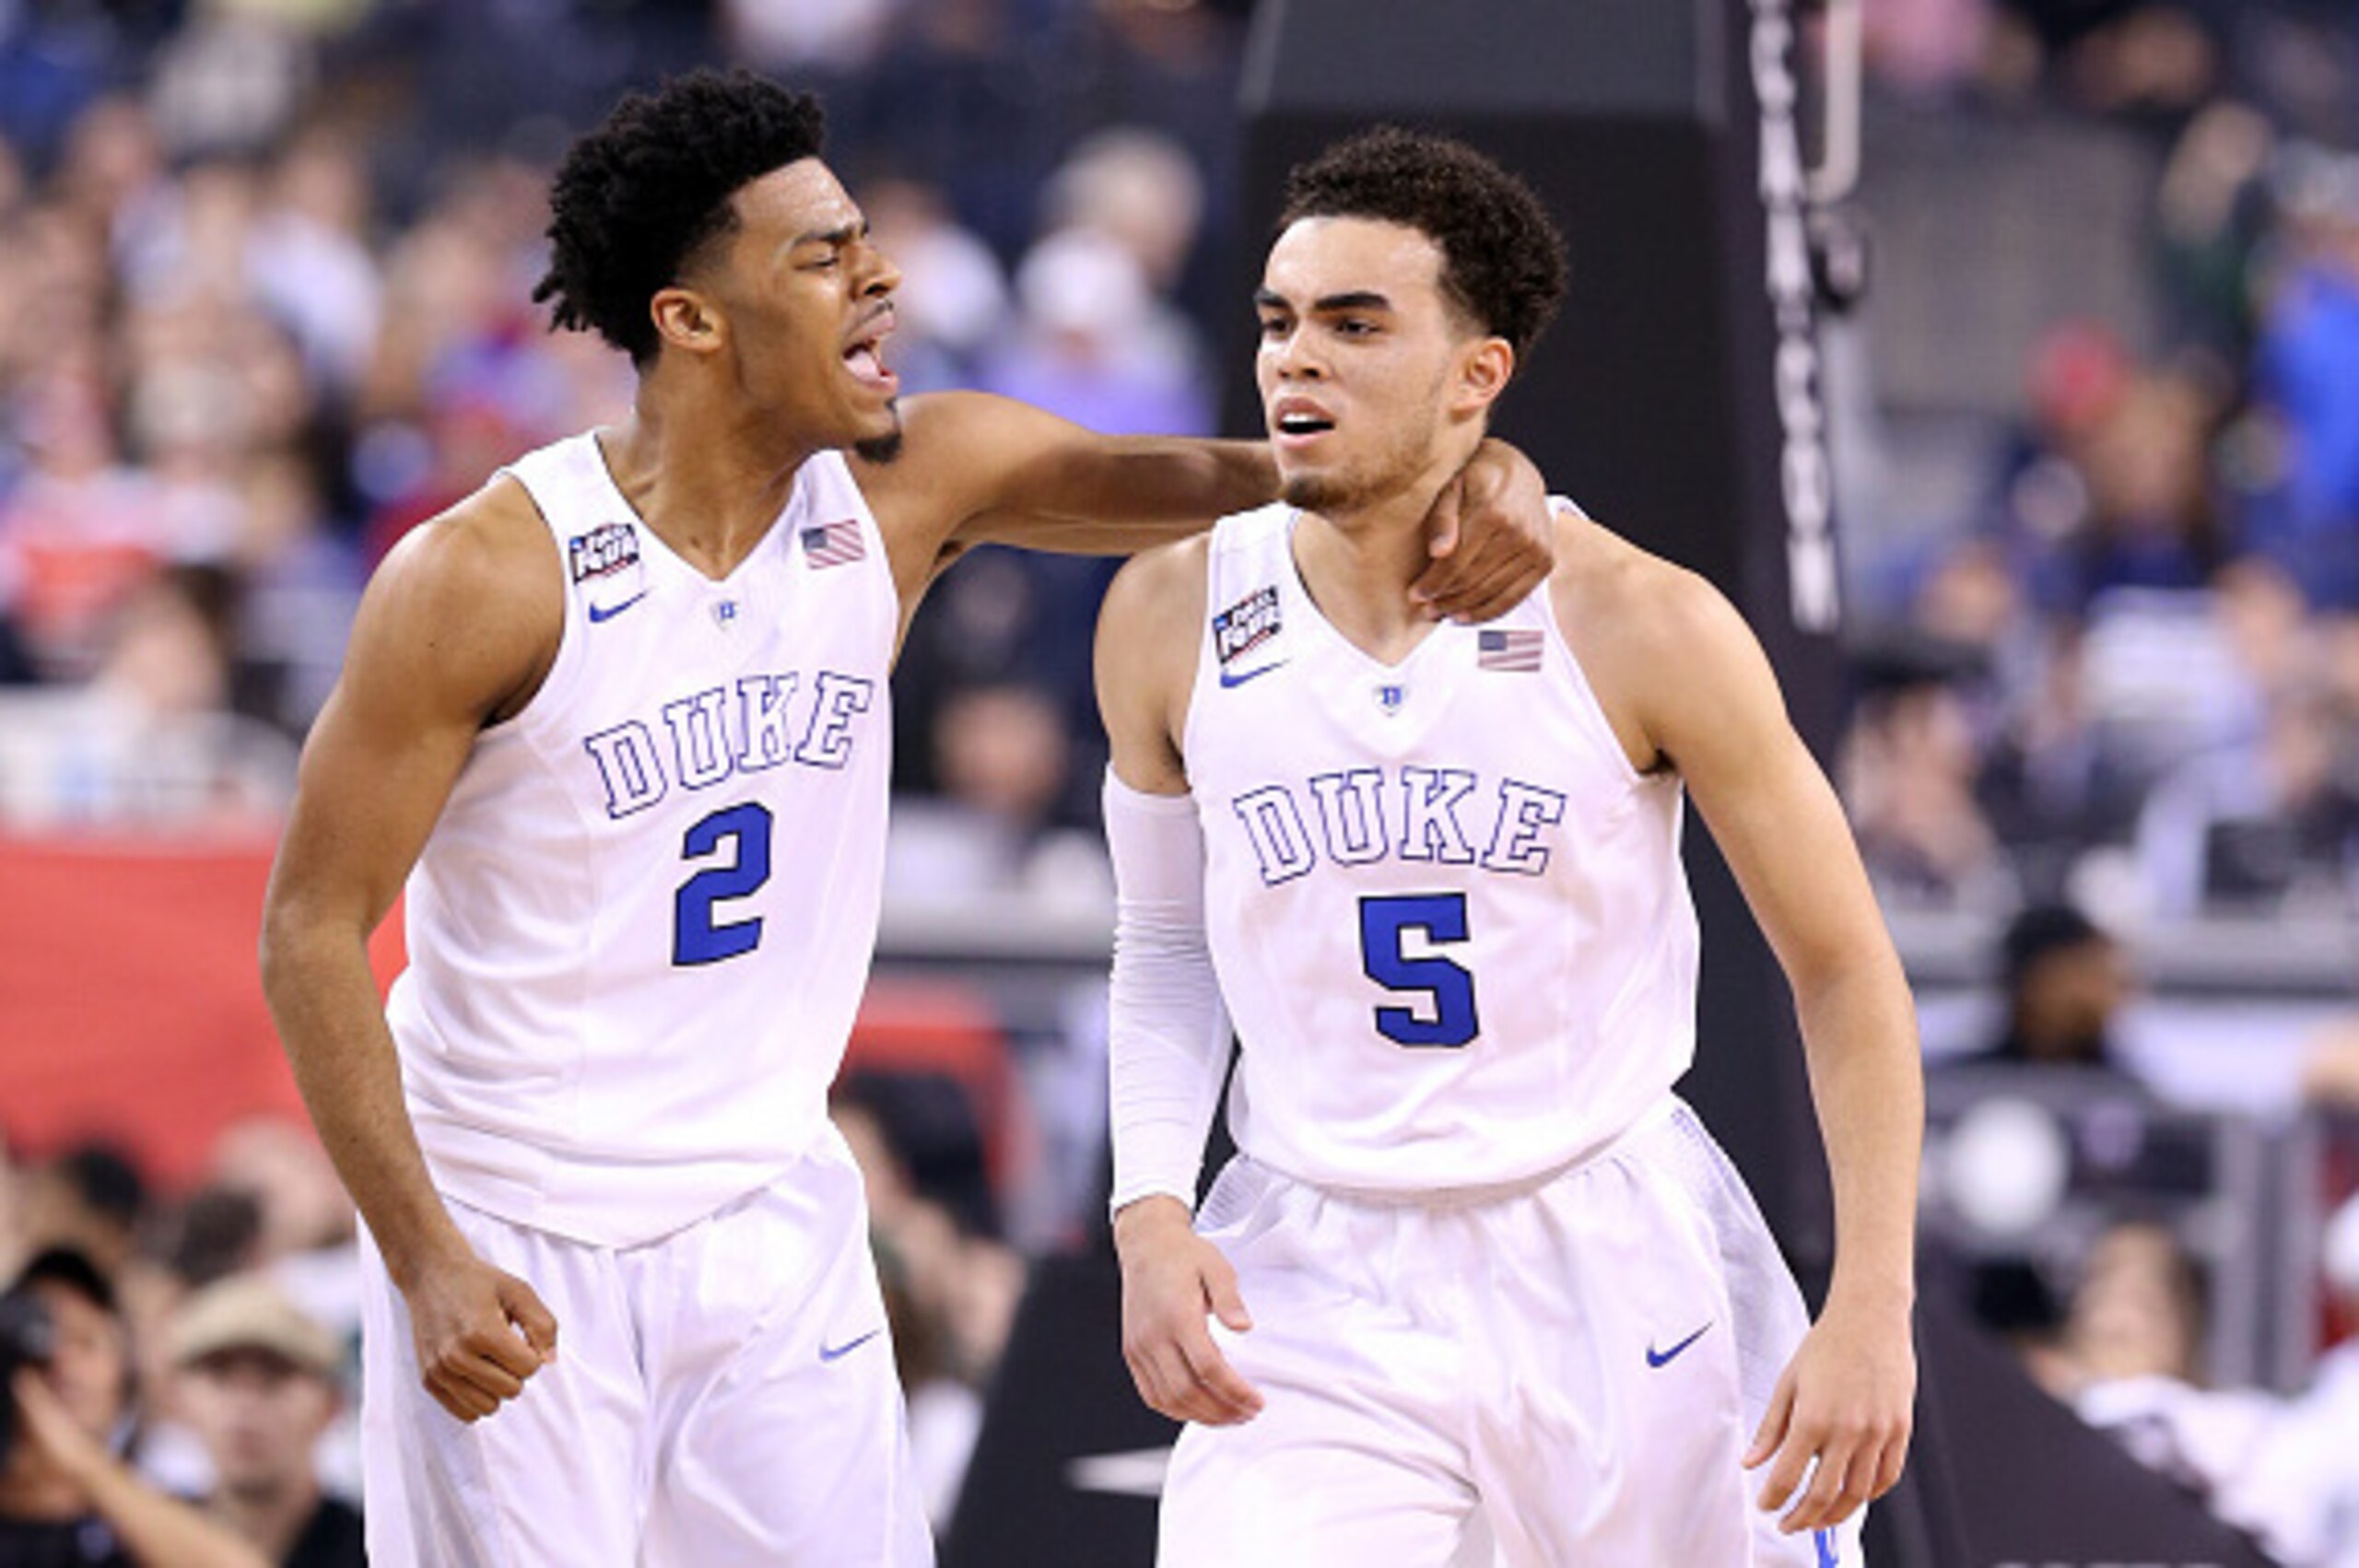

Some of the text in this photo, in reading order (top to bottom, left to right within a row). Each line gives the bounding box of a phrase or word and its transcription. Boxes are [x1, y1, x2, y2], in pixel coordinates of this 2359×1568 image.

[583, 671, 874, 819] DUKE
[672, 801, 773, 966] 2
[1232, 766, 1567, 886] DUKE
[1358, 892, 1479, 1048] 5
